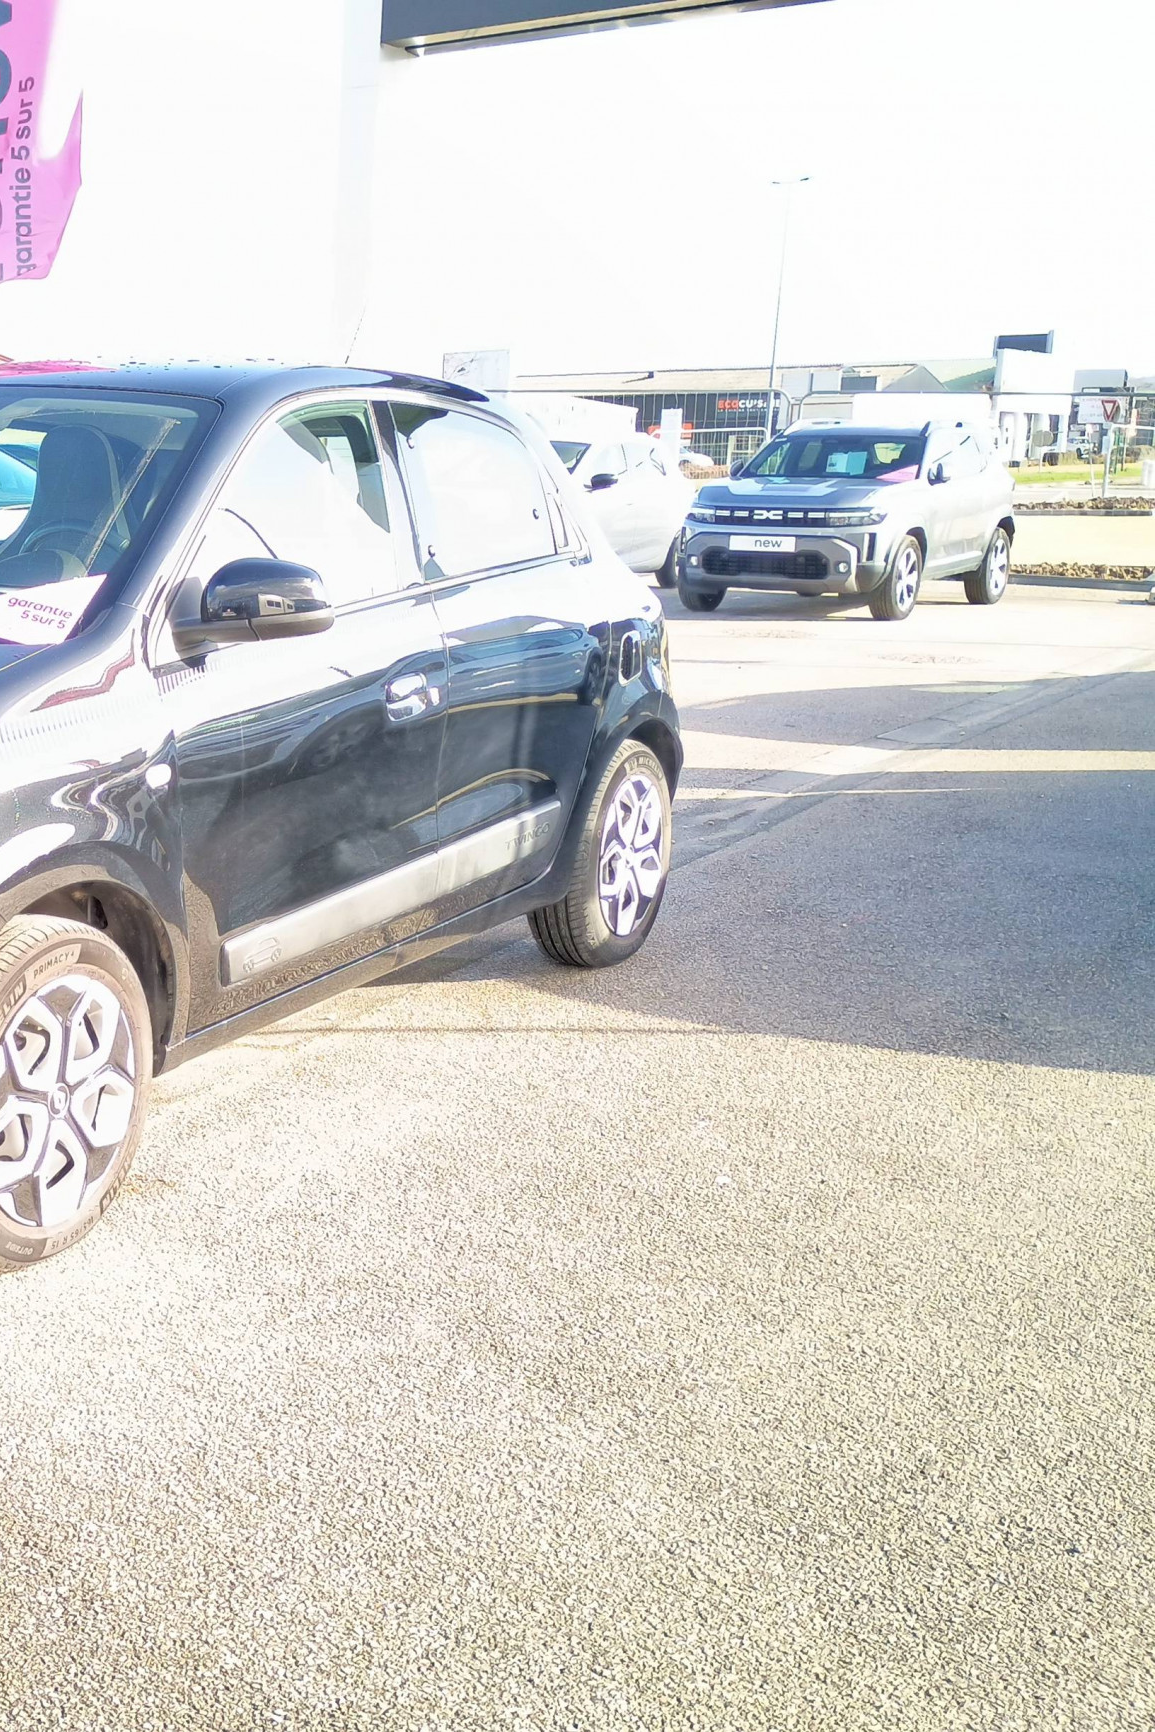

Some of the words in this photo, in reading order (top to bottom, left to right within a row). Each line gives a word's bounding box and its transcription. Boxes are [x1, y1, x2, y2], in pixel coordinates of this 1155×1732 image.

[18, 76, 35, 93] 5
[15, 98, 33, 140] sur
[11, 145, 30, 161] 5
[9, 167, 36, 276] garantie
[7, 596, 73, 620] garantie
[20, 609, 29, 620] 5
[31, 613, 55, 626] sur
[57, 619, 66, 630] 5
[505, 821, 550, 850] TWINGO
[33, 952, 70, 980] PRIMACY
